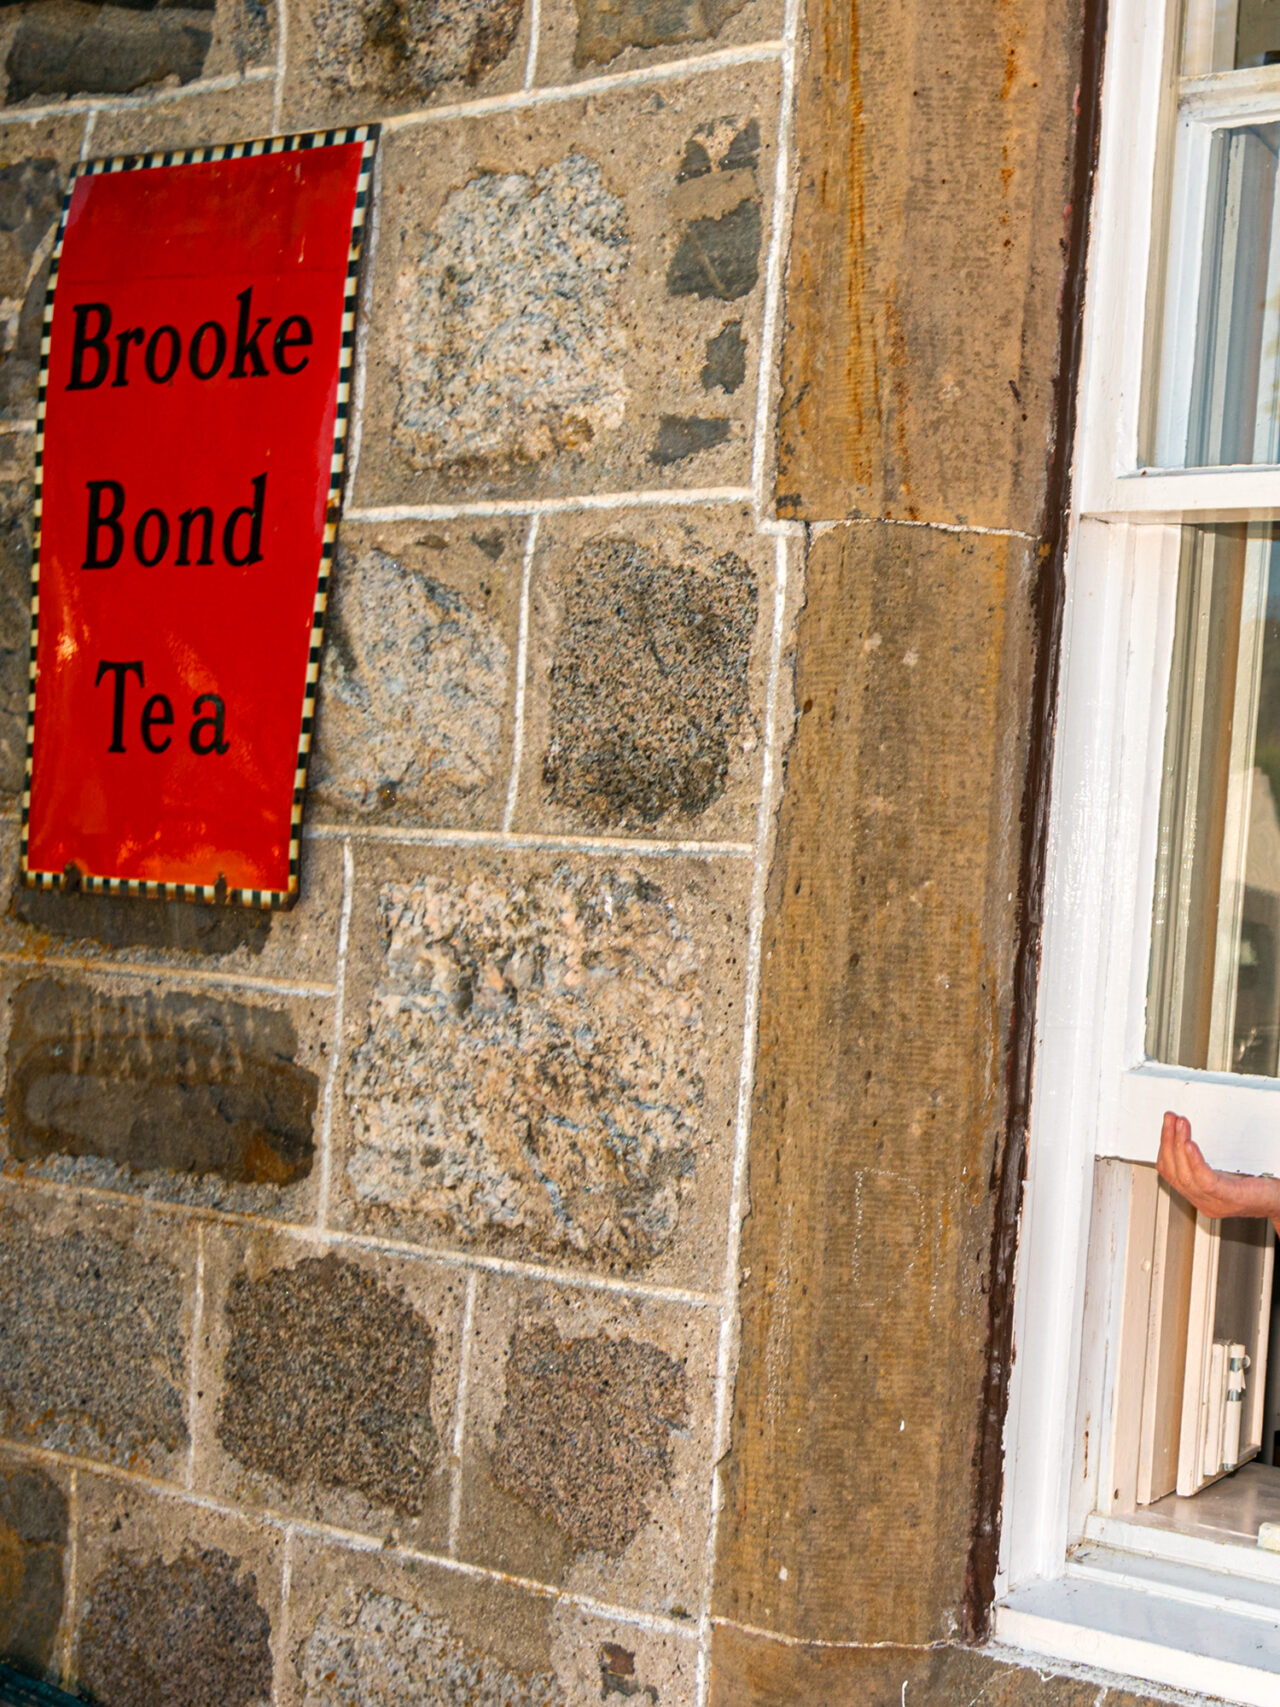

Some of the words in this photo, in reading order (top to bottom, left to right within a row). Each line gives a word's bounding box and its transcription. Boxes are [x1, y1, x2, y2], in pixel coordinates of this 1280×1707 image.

[65, 286, 314, 391] Brooke
[80, 471, 269, 571] Bond
[95, 659, 231, 755] Tea
